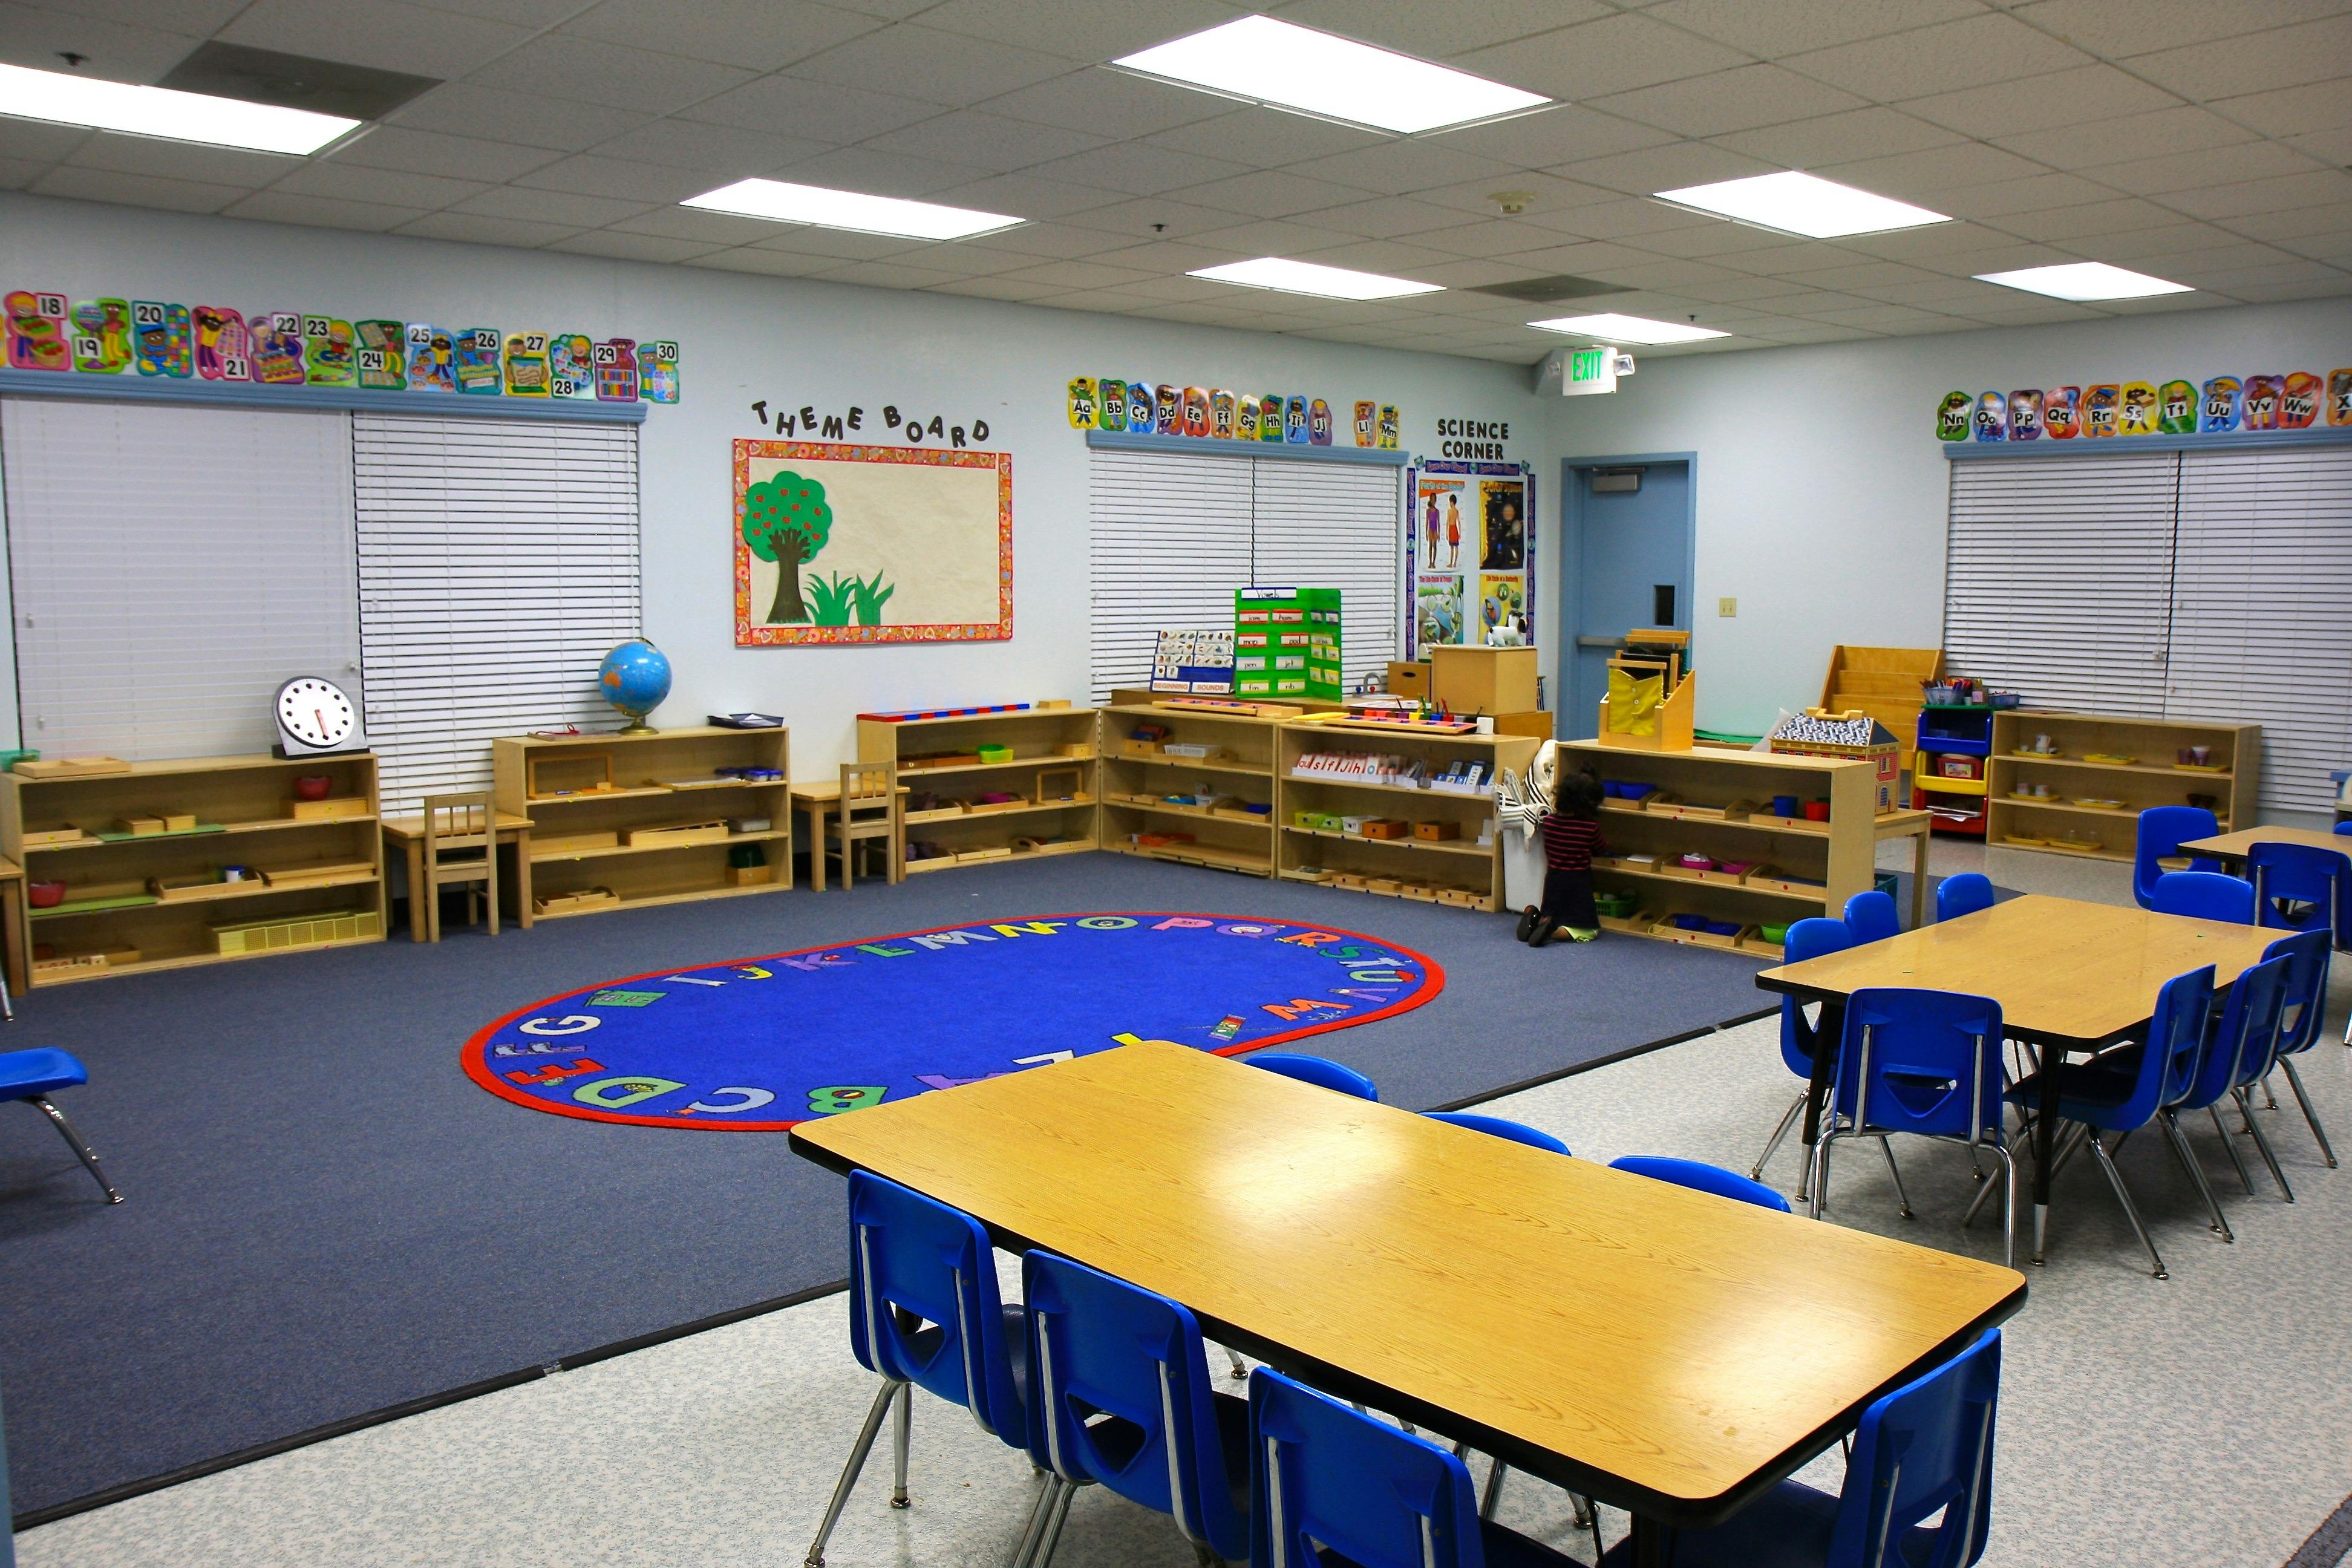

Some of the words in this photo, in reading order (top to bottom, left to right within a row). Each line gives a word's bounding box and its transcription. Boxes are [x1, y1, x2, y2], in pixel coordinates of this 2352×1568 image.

[41, 298, 60, 315] 18
[79, 339, 97, 354] 19
[137, 306, 162, 322] 20
[226, 359, 244, 376] 21
[276, 318, 295, 333] 22
[309, 320, 327, 336] 23
[362, 351, 381, 368] 24
[411, 328, 430, 344] 25
[478, 333, 496, 348] 26
[528, 336, 543, 351] 27
[555, 380, 572, 395] 28
[598, 347, 615, 362] 29
[658, 344, 675, 359] 30
[1573, 351, 1602, 381] EXIT
[751, 400, 863, 440] THEME
[883, 406, 989, 448] BOARD
[1073, 400, 1091, 414] Aa
[1108, 402, 1122, 414] Bb
[1132, 407, 1145, 419] Cc
[1160, 407, 1174, 419] Dd
[1187, 409, 1201, 421] Ee
[1218, 413, 1229, 423] Ff
[1241, 417, 1254, 431] Gg
[1266, 416, 1279, 426] Hh
[1292, 416, 1301, 425] Ii
[1315, 419, 1326, 432] Jj
[1359, 422, 1368, 432] Ll
[1382, 425, 1397, 437] Mm
[1944, 414, 1963, 425] Nn
[1978, 412, 1996, 424] Oo
[2014, 414, 2033, 426] Pp
[2048, 410, 2069, 424] Qq
[2092, 411, 2111, 422] Rr
[2125, 407, 2142, 419] Ss
[2168, 403, 2184, 416] Tt
[2208, 403, 2229, 416] Uu
[2249, 400, 2270, 412] Vv
[2284, 399, 2311, 414] Ww
[1437, 419, 1509, 440] SCIENCE
[1442, 441, 1503, 460] CORNER
[1076, 916, 1139, 930] O
[1150, 917, 1214, 930] P
[1215, 923, 1279, 938] Q
[908, 930, 998, 950] M
[1274, 932, 1342, 947] R
[774, 952, 862, 972] K
[518, 1015, 602, 1036] G
[503, 1057, 609, 1086] E
[572, 1076, 688, 1109] D
[687, 1085, 777, 1114] C
[806, 1085, 889, 1114] B
